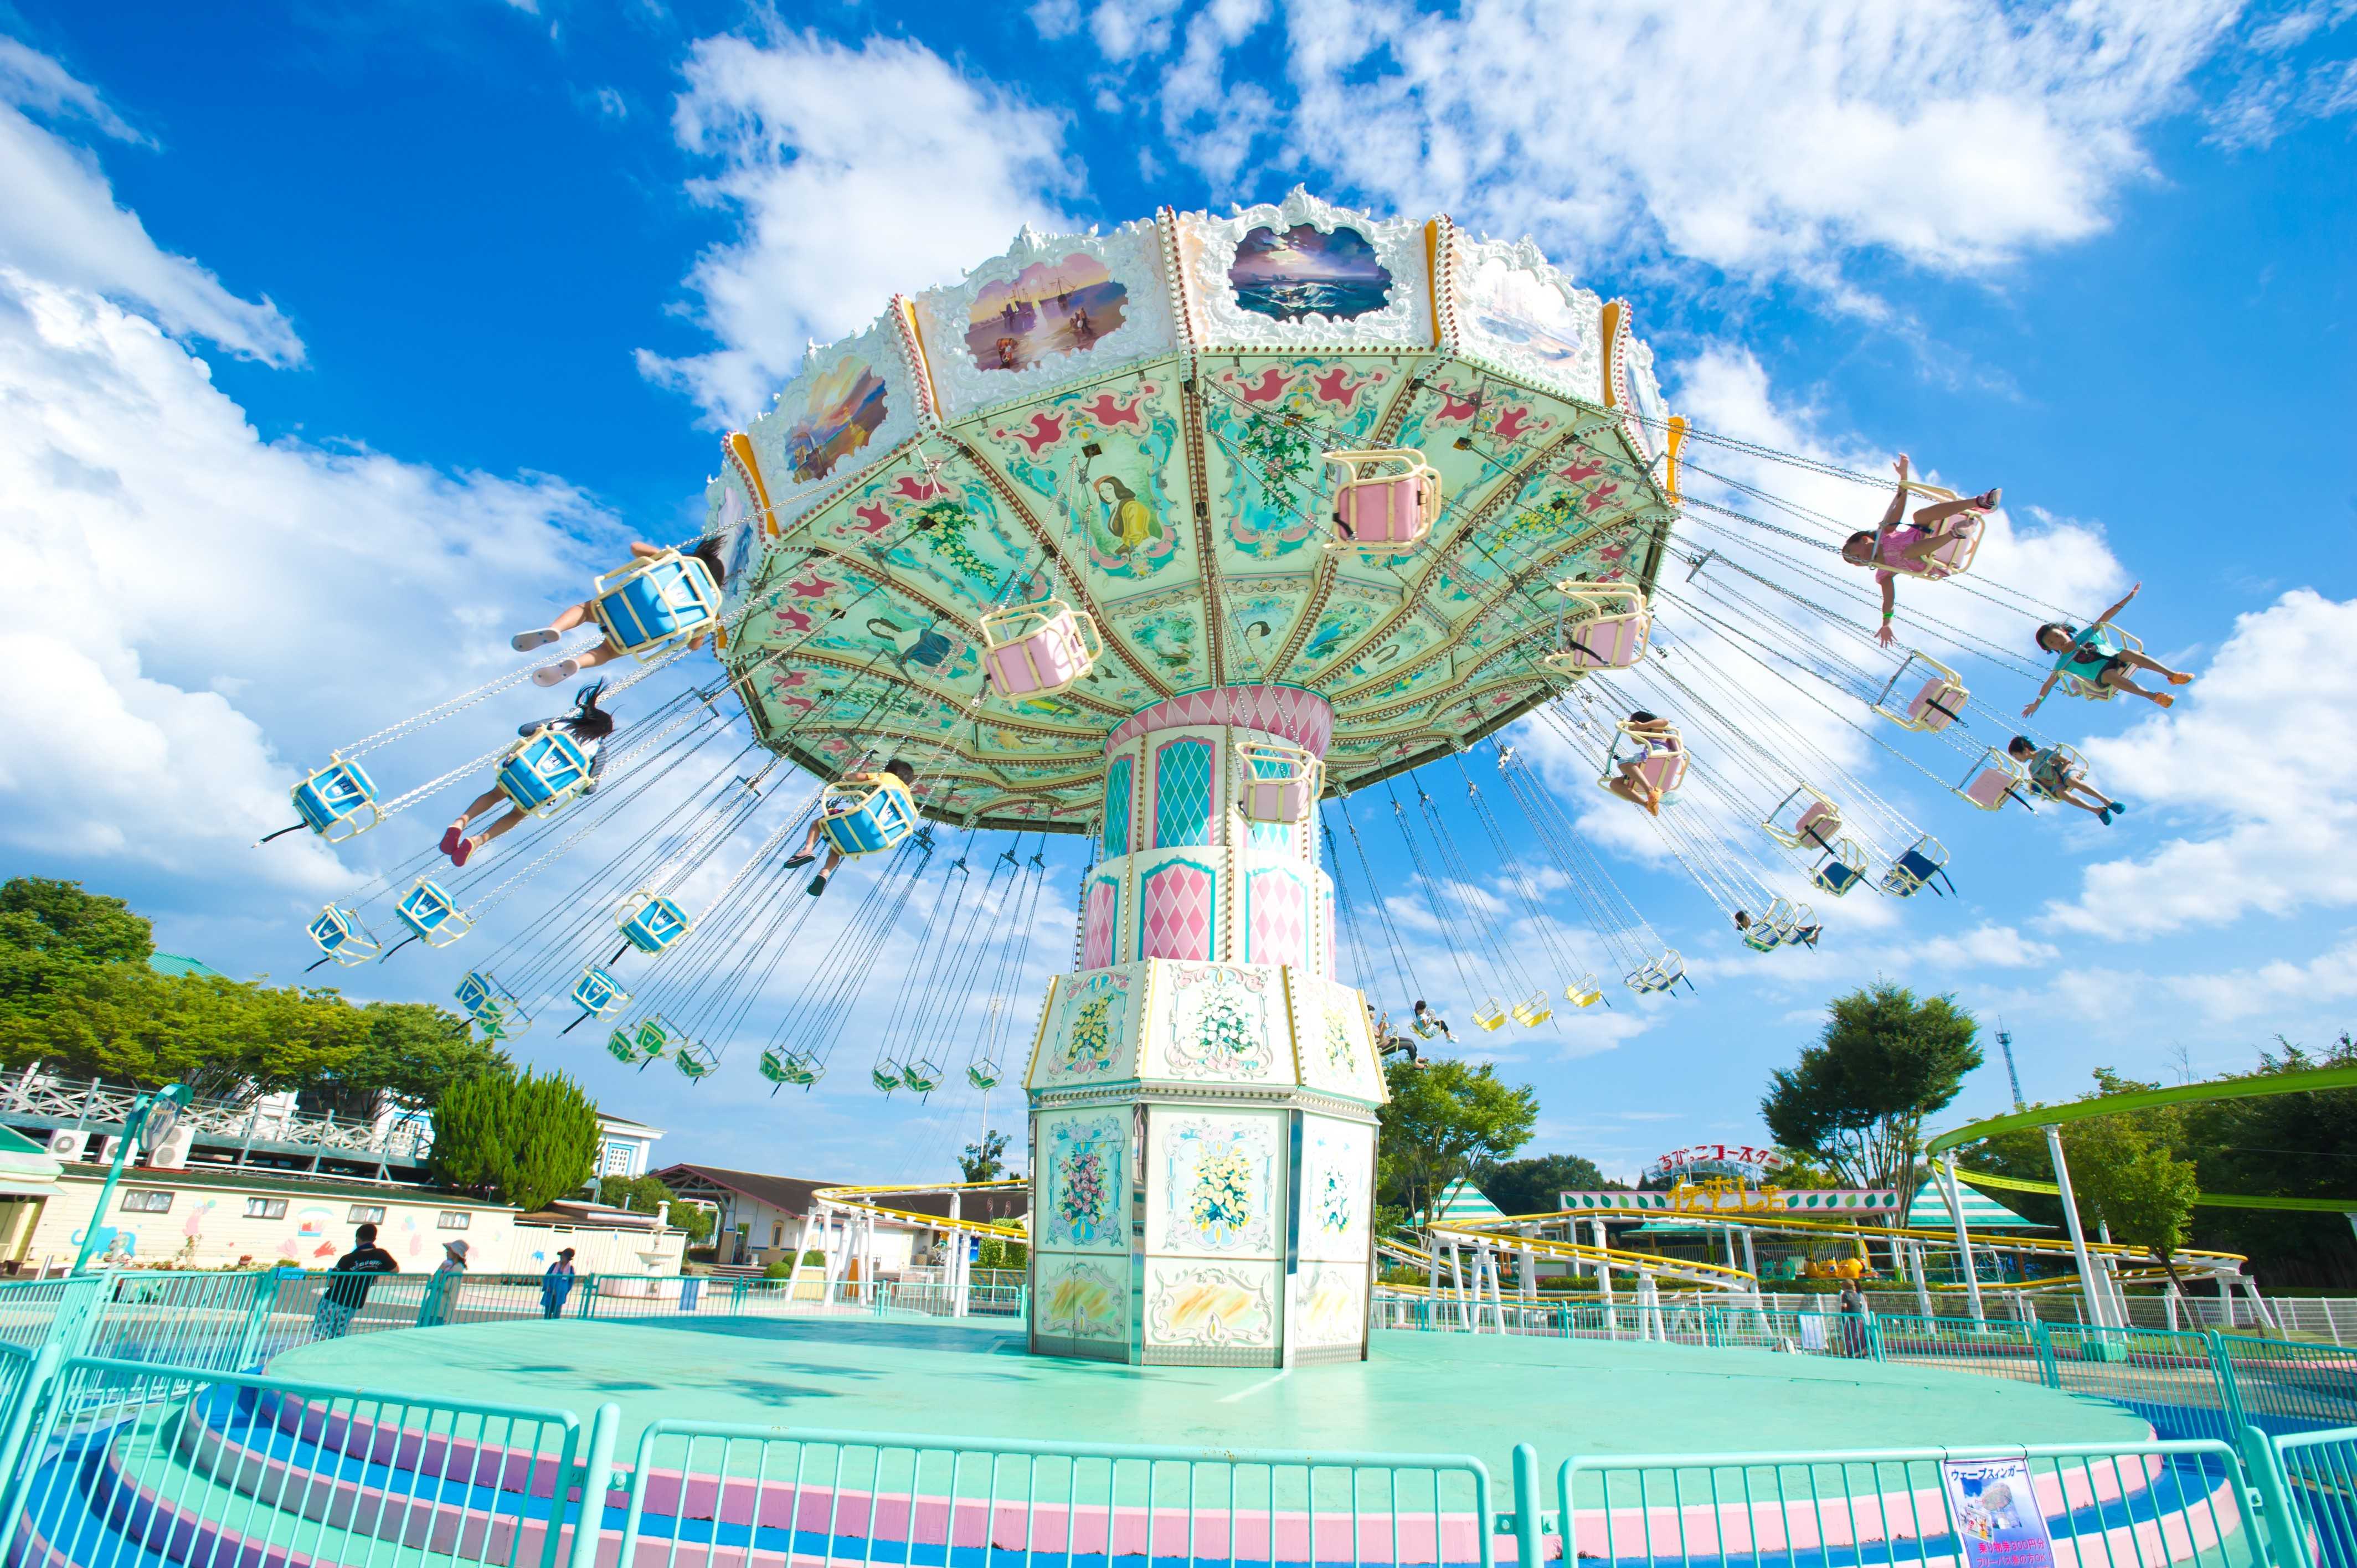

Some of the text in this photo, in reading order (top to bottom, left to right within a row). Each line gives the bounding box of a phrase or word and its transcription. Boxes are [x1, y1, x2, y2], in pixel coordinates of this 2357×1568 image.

[1659, 1145, 1781, 1170] ちびっこコースター
